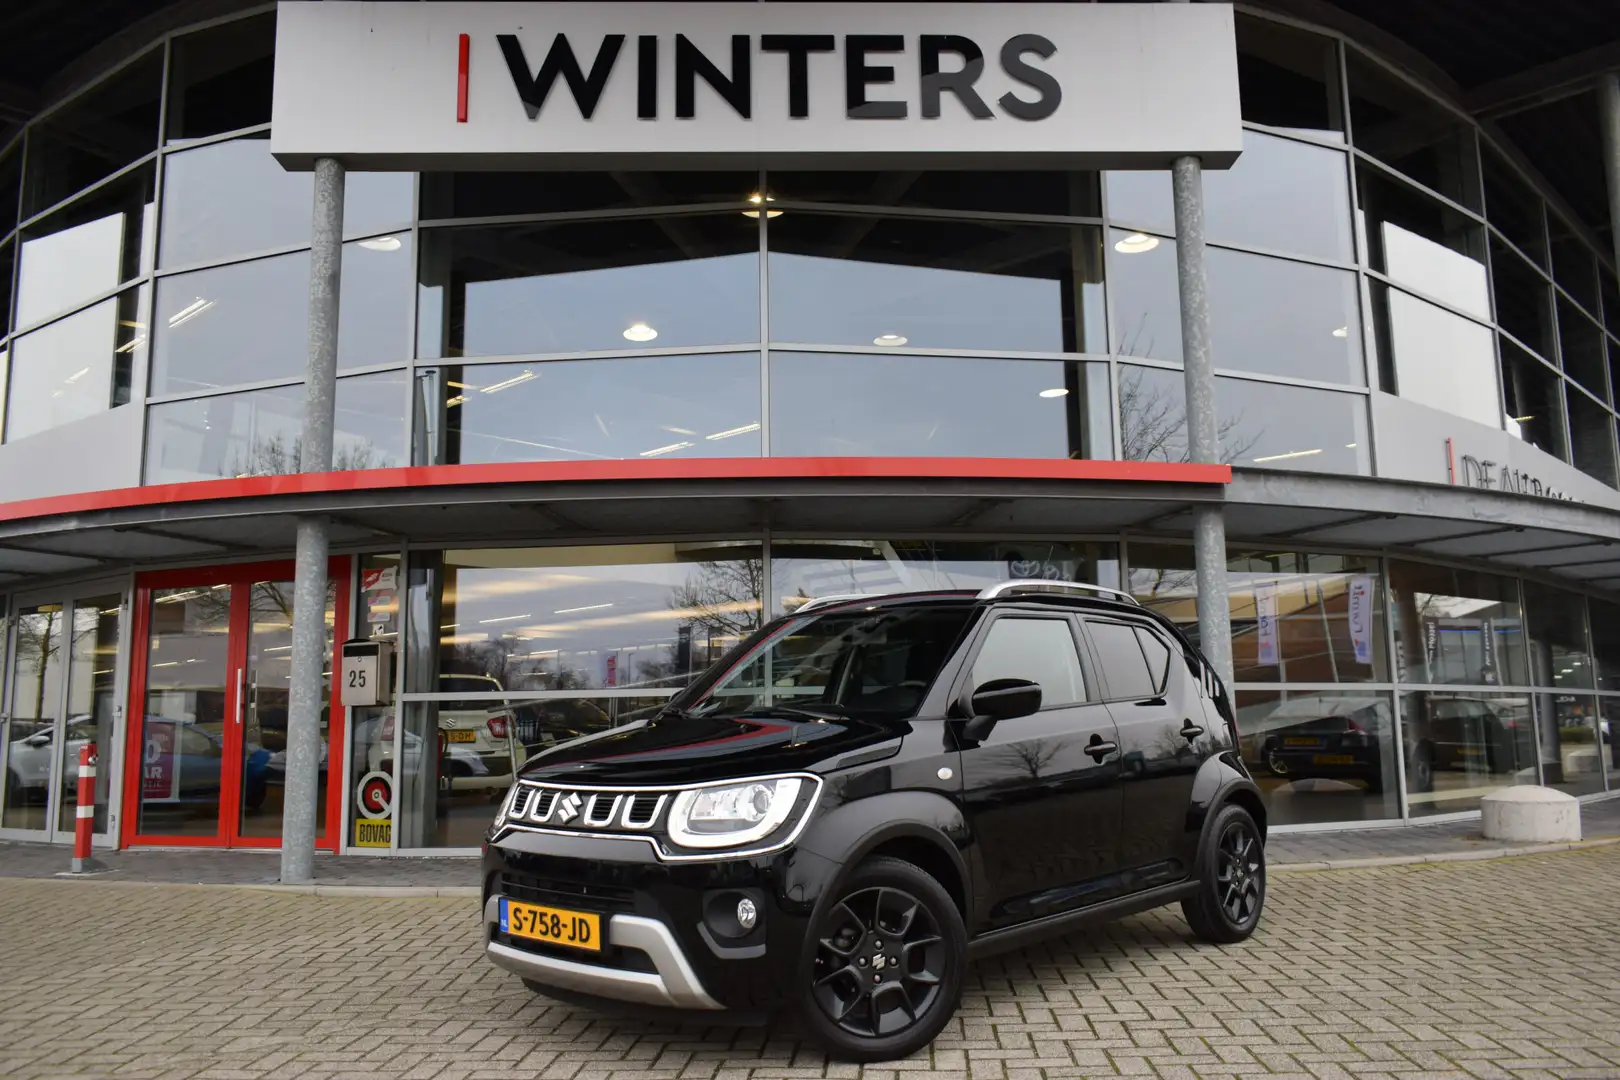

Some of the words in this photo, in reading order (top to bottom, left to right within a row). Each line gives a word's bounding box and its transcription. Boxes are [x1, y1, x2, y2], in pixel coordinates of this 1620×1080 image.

[496, 33, 1063, 121] WINTERS
[349, 670, 366, 688] 25
[513, 906, 591, 943] S-758-JD
